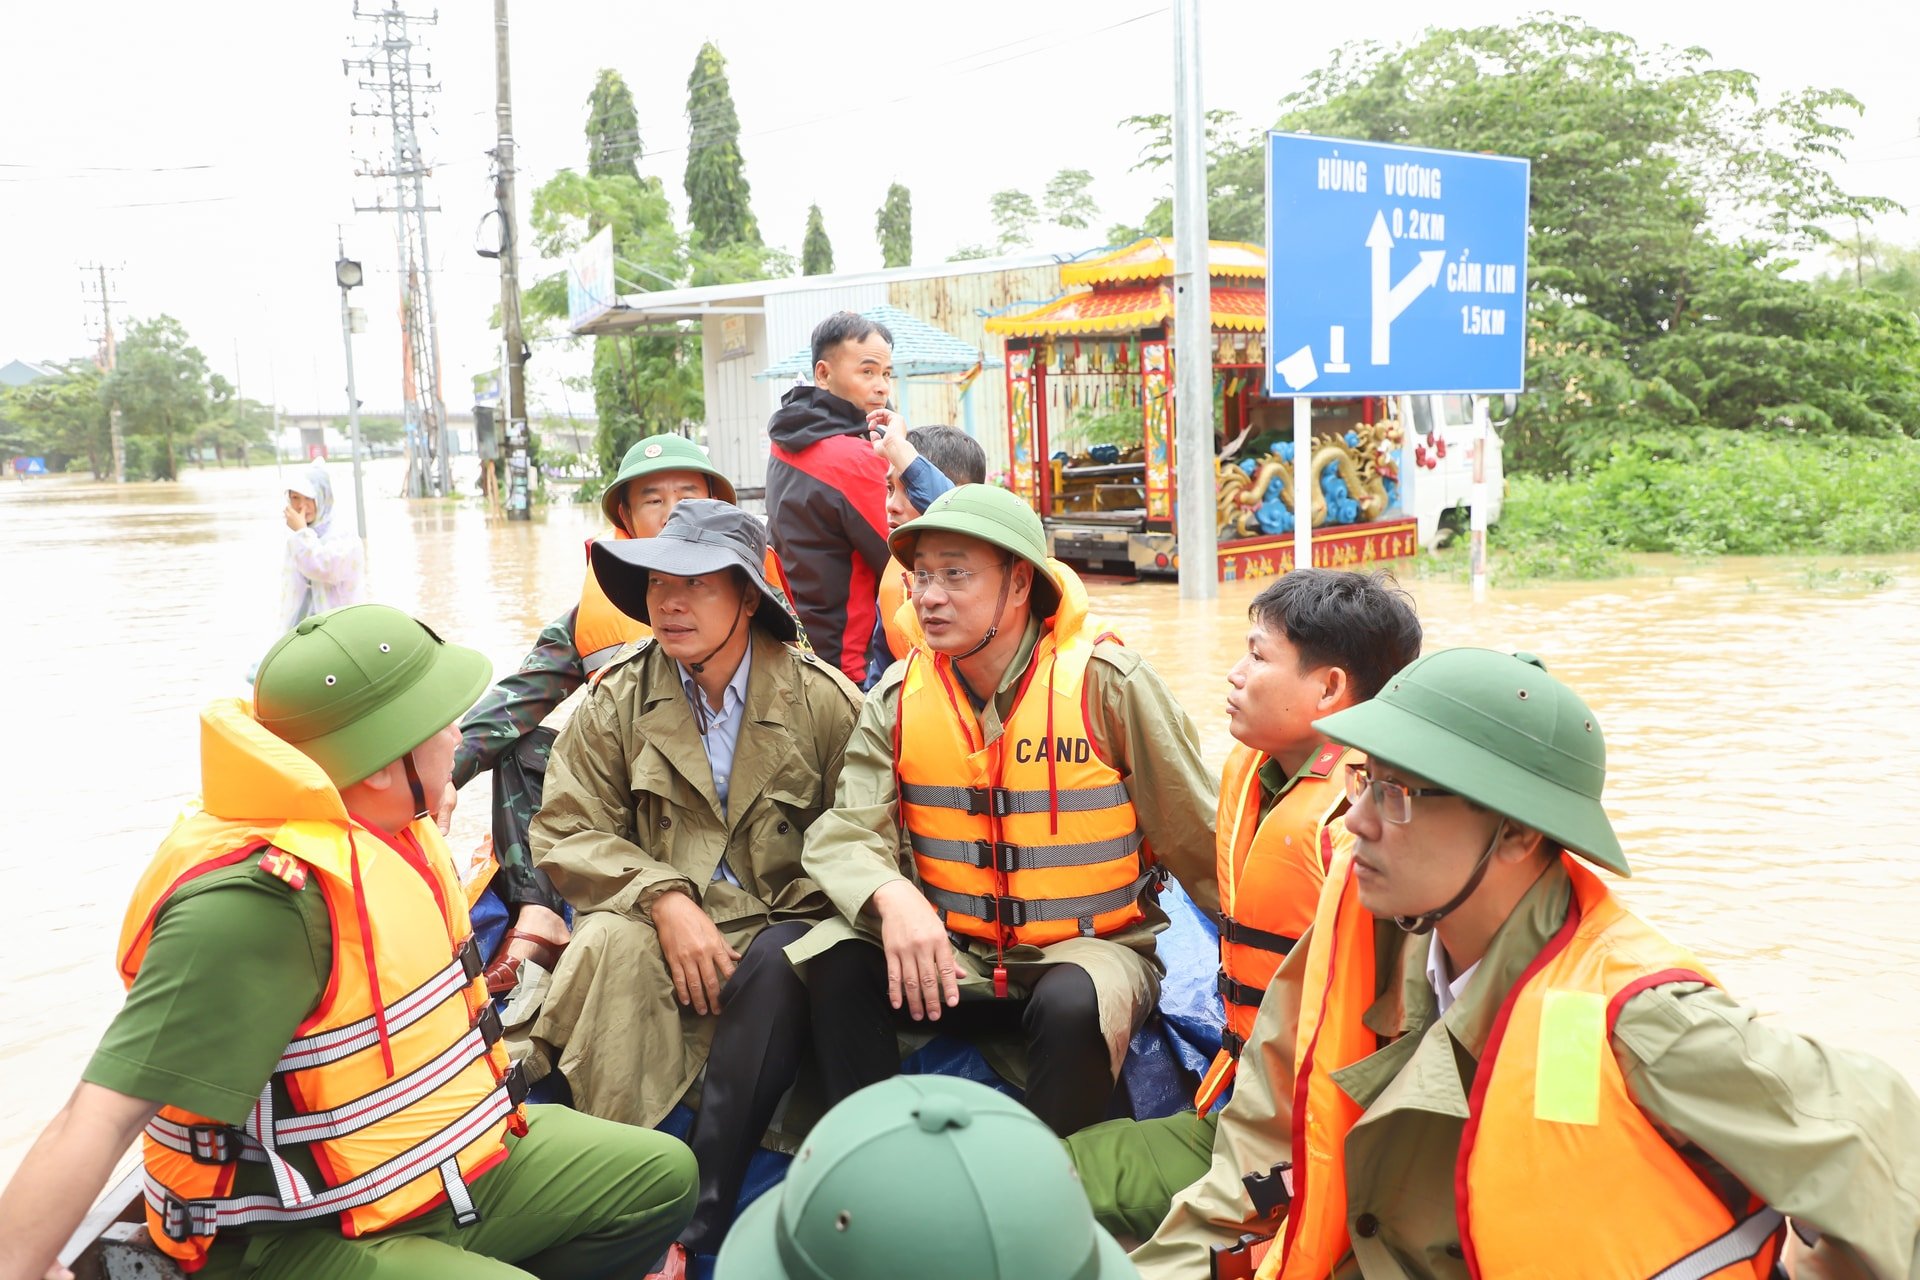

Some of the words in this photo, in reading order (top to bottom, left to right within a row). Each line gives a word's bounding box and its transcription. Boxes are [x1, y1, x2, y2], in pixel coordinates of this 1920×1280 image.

[1318, 149, 1367, 193] HÙNG
[1384, 162, 1441, 199] VƯƠNG
[1392, 207, 1445, 241] 0.2KM
[1447, 248, 1482, 292] CẨM
[1485, 264, 1516, 294] KIM
[1461, 305, 1505, 335] 1.5KM
[1015, 736, 1090, 764] CAND
